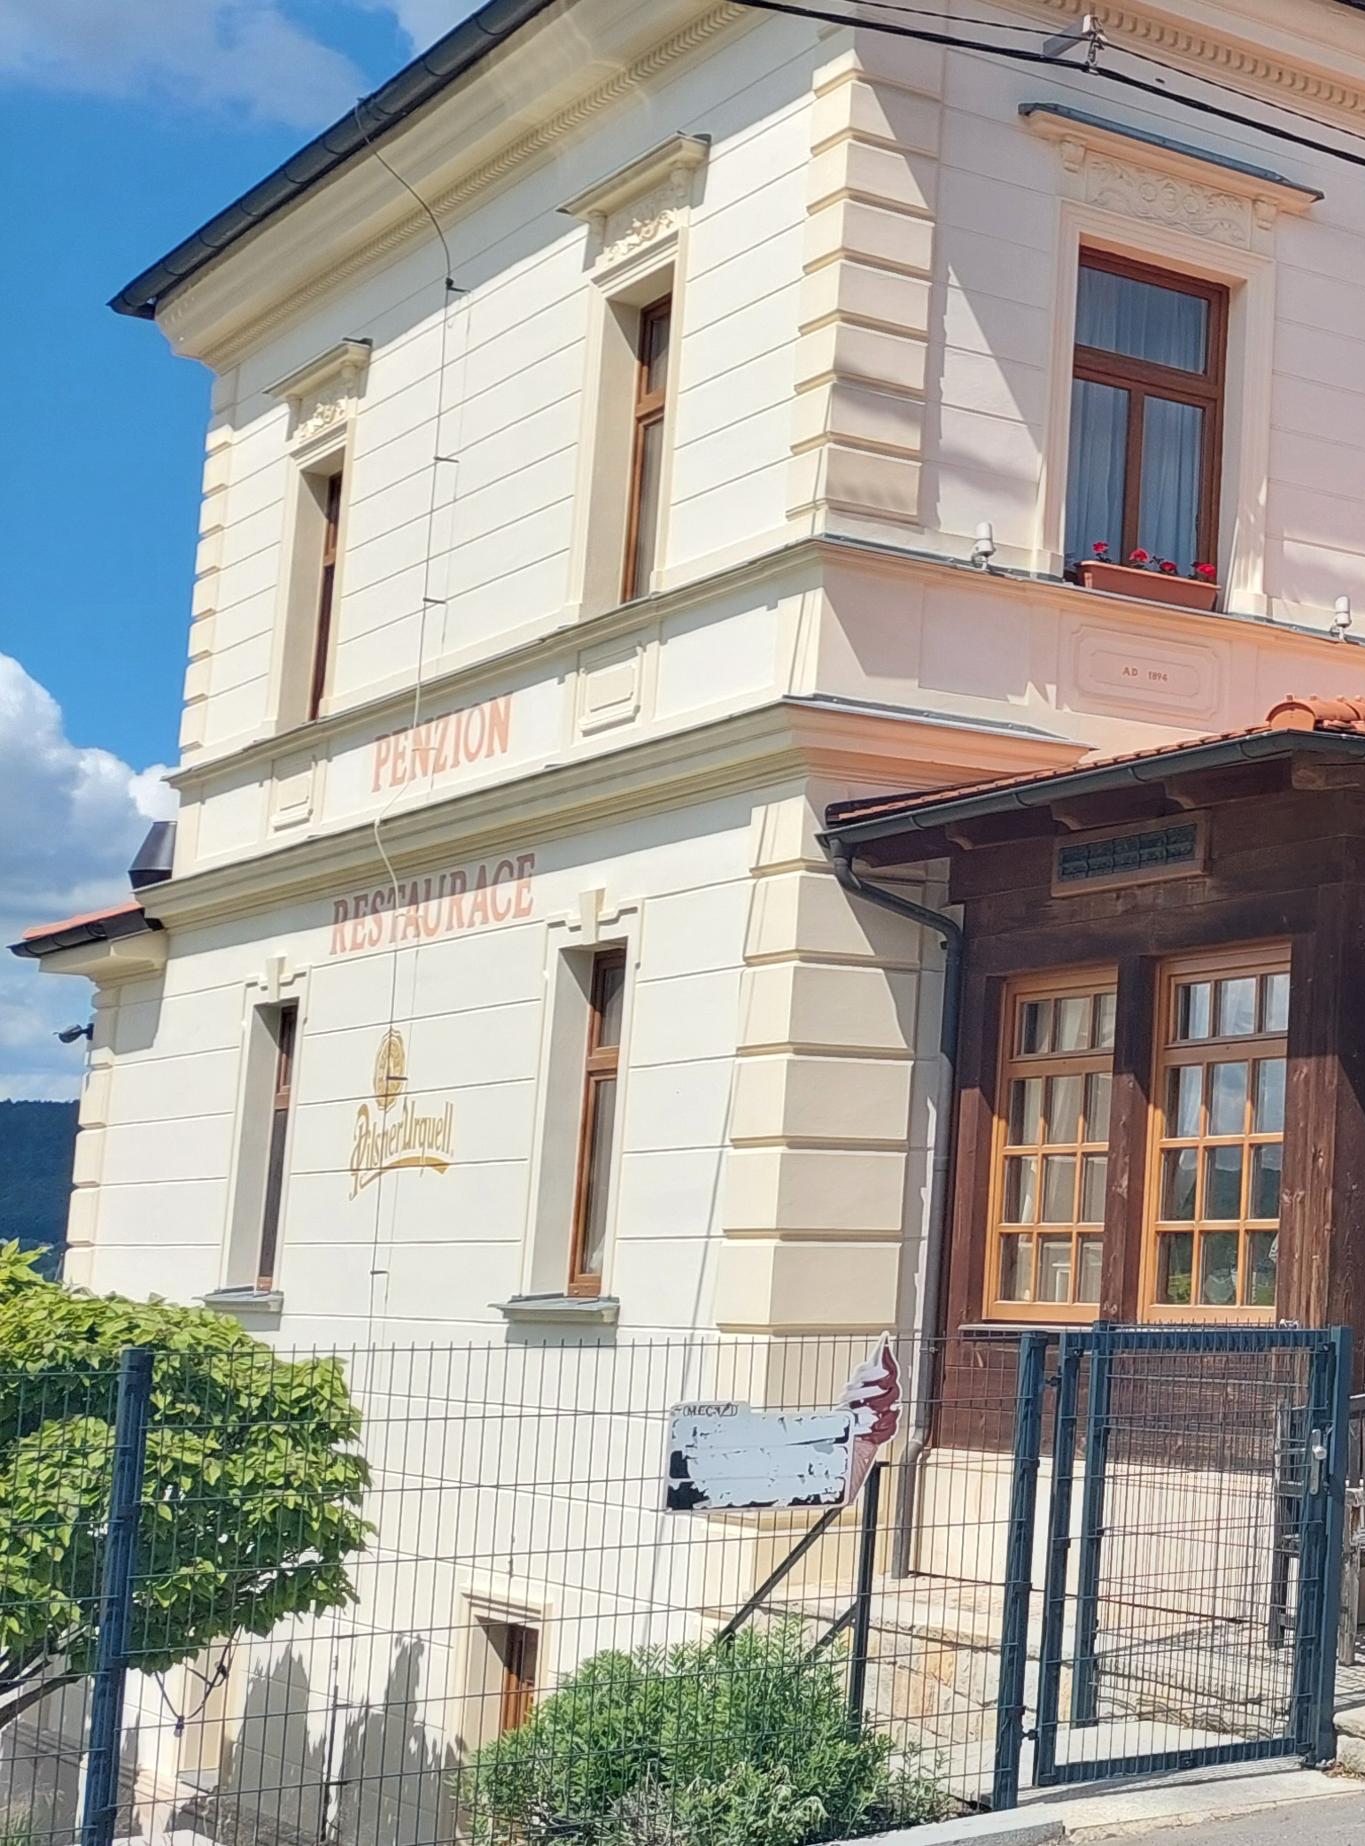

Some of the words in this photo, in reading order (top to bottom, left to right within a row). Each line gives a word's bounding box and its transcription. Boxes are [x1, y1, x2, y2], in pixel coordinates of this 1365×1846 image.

[1123, 667, 1138, 676] AD
[1149, 671, 1168, 681] 1894
[371, 691, 513, 792] PENZION
[329, 853, 536, 955] RESTAURACE
[349, 1103, 404, 1201] Pilsner
[403, 1096, 453, 1154] Urquell
